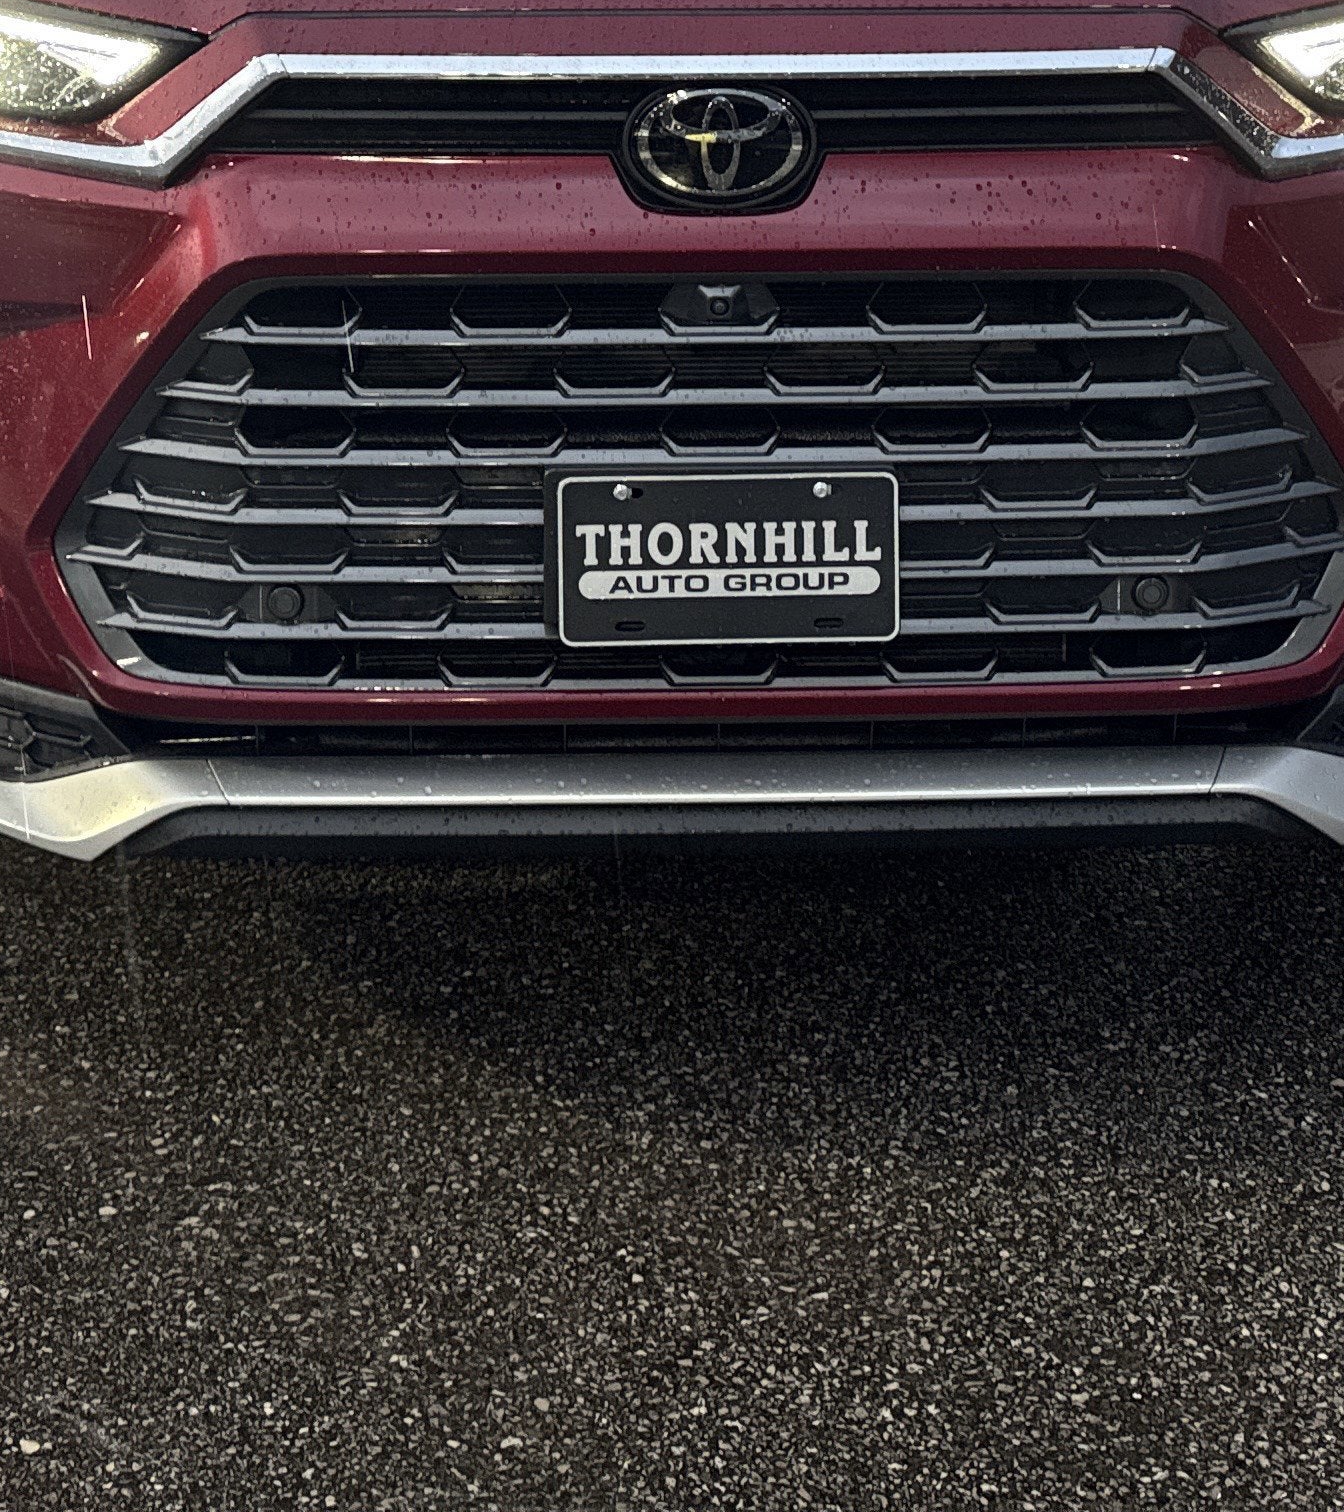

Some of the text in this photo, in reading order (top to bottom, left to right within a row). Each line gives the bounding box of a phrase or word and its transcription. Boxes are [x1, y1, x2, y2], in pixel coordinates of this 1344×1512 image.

[575, 519, 882, 567] THORNHILL
[608, 571, 850, 595] AUTO GROUP
